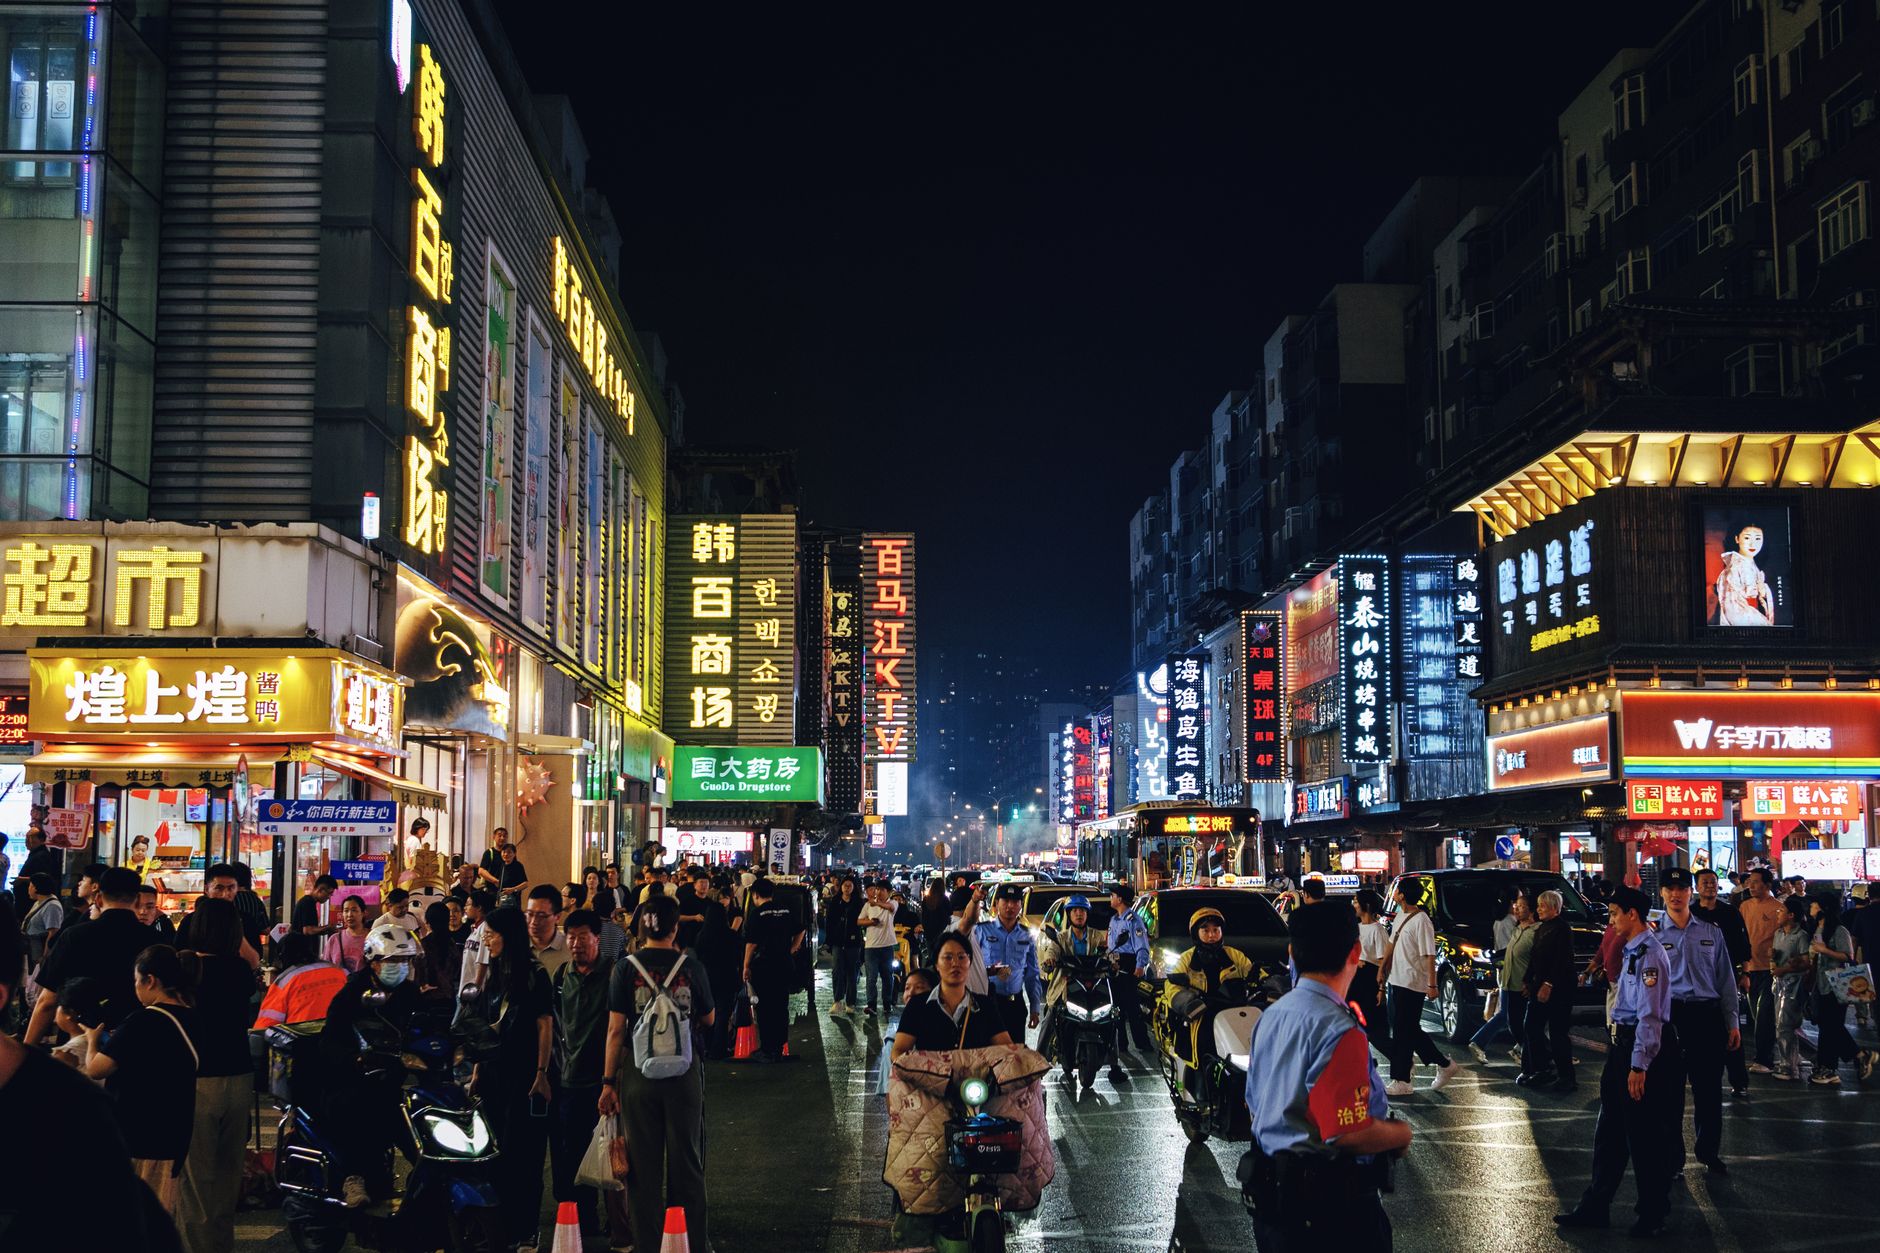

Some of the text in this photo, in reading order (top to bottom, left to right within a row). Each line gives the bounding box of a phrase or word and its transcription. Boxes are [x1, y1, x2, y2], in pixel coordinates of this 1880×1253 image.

[403, 44, 445, 555] 韩百商场
[0, 542, 204, 630] 超市
[690, 522, 735, 728] 韩百商场
[750, 577, 782, 723] 한백쇼핑
[832, 592, 853, 728] 百马江KTV
[870, 539, 908, 754] 百马江KTV
[65, 664, 250, 724] 煌上煌
[255, 672, 280, 724] 酱鸭
[1253, 669, 1276, 720] 桌球
[54, 770, 91, 781] 煌上煌
[127, 770, 163, 781] 煌上煌
[691, 756, 801, 780] 国大药房
[700, 781, 792, 794] GuoDa Drugstore
[1636, 787, 1660, 799] 중국
[1665, 785, 1717, 803] 糕八戒
[1792, 786, 1848, 804] 糕八戒
[270, 825, 278, 833] 西
[378, 825, 386, 833] 东
